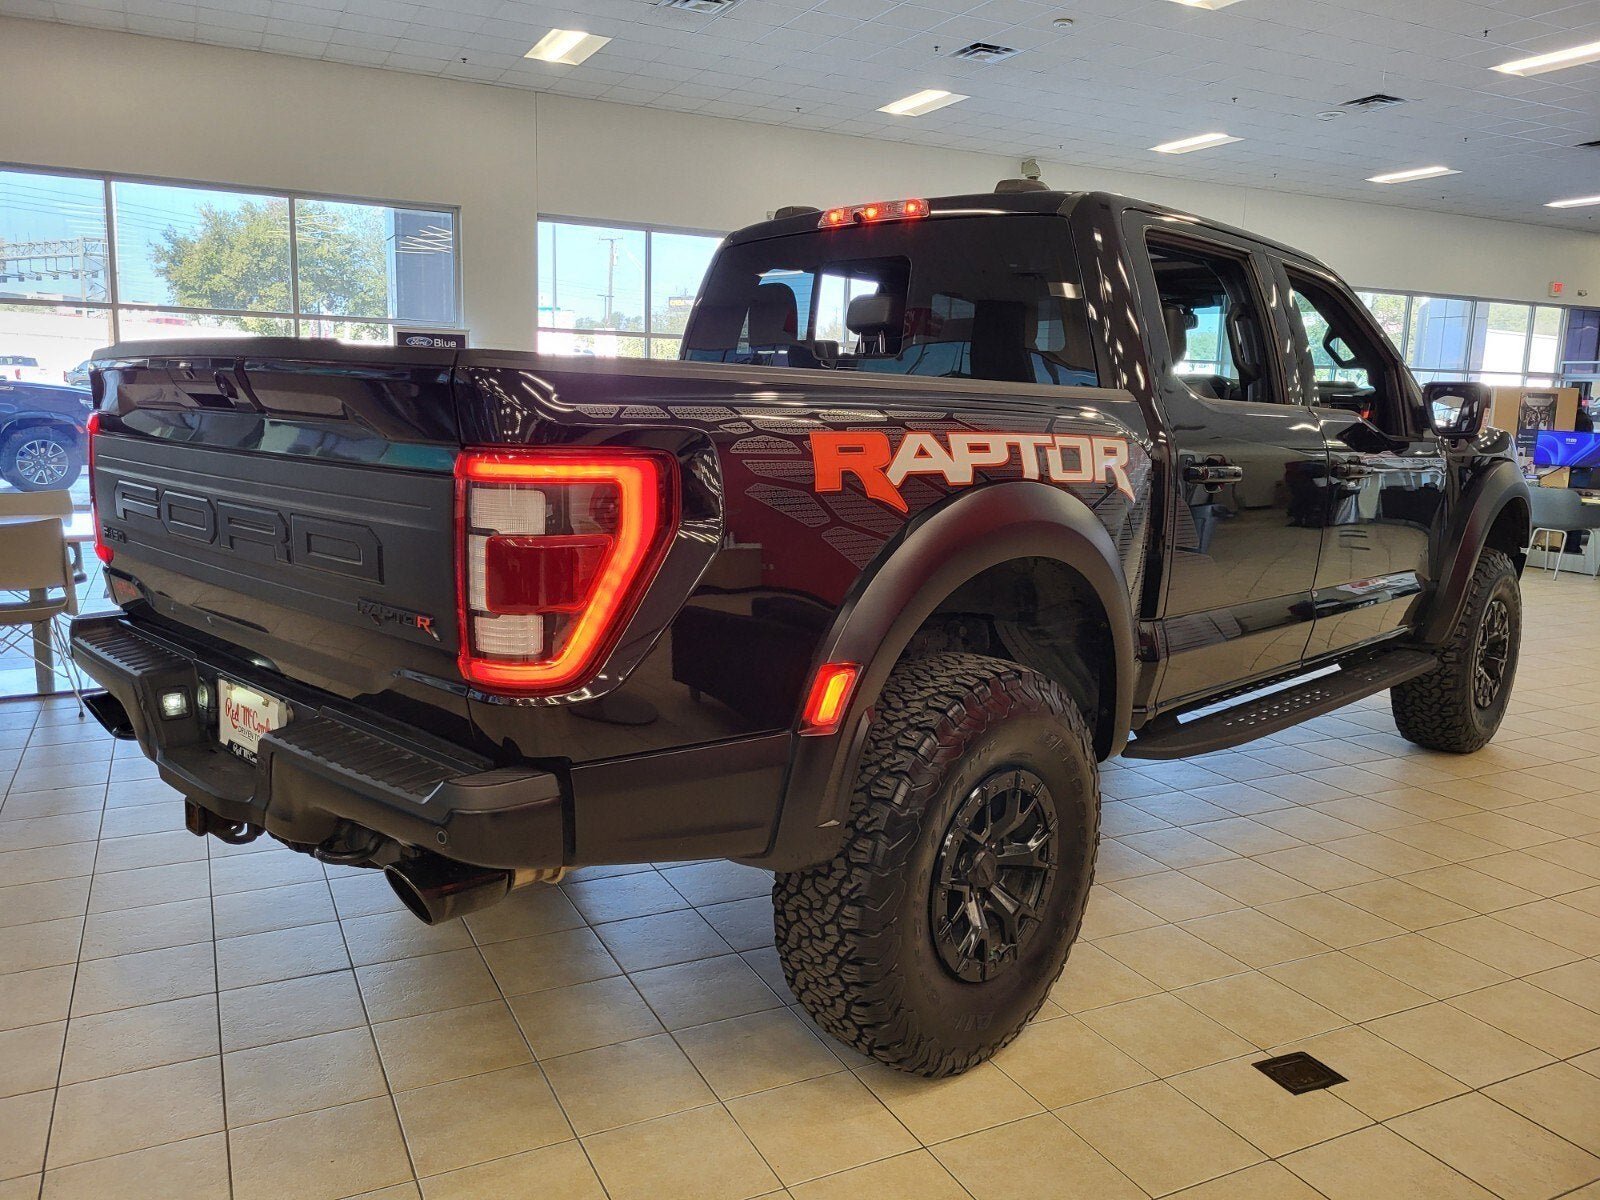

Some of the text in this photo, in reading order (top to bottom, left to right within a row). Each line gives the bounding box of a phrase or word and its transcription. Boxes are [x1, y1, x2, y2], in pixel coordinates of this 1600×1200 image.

[433, 338, 457, 348] Blue
[810, 430, 1136, 513] RAPTOR
[114, 479, 385, 586] FORD
[358, 597, 441, 641] RAPTOR
[225, 697, 240, 730] Red
